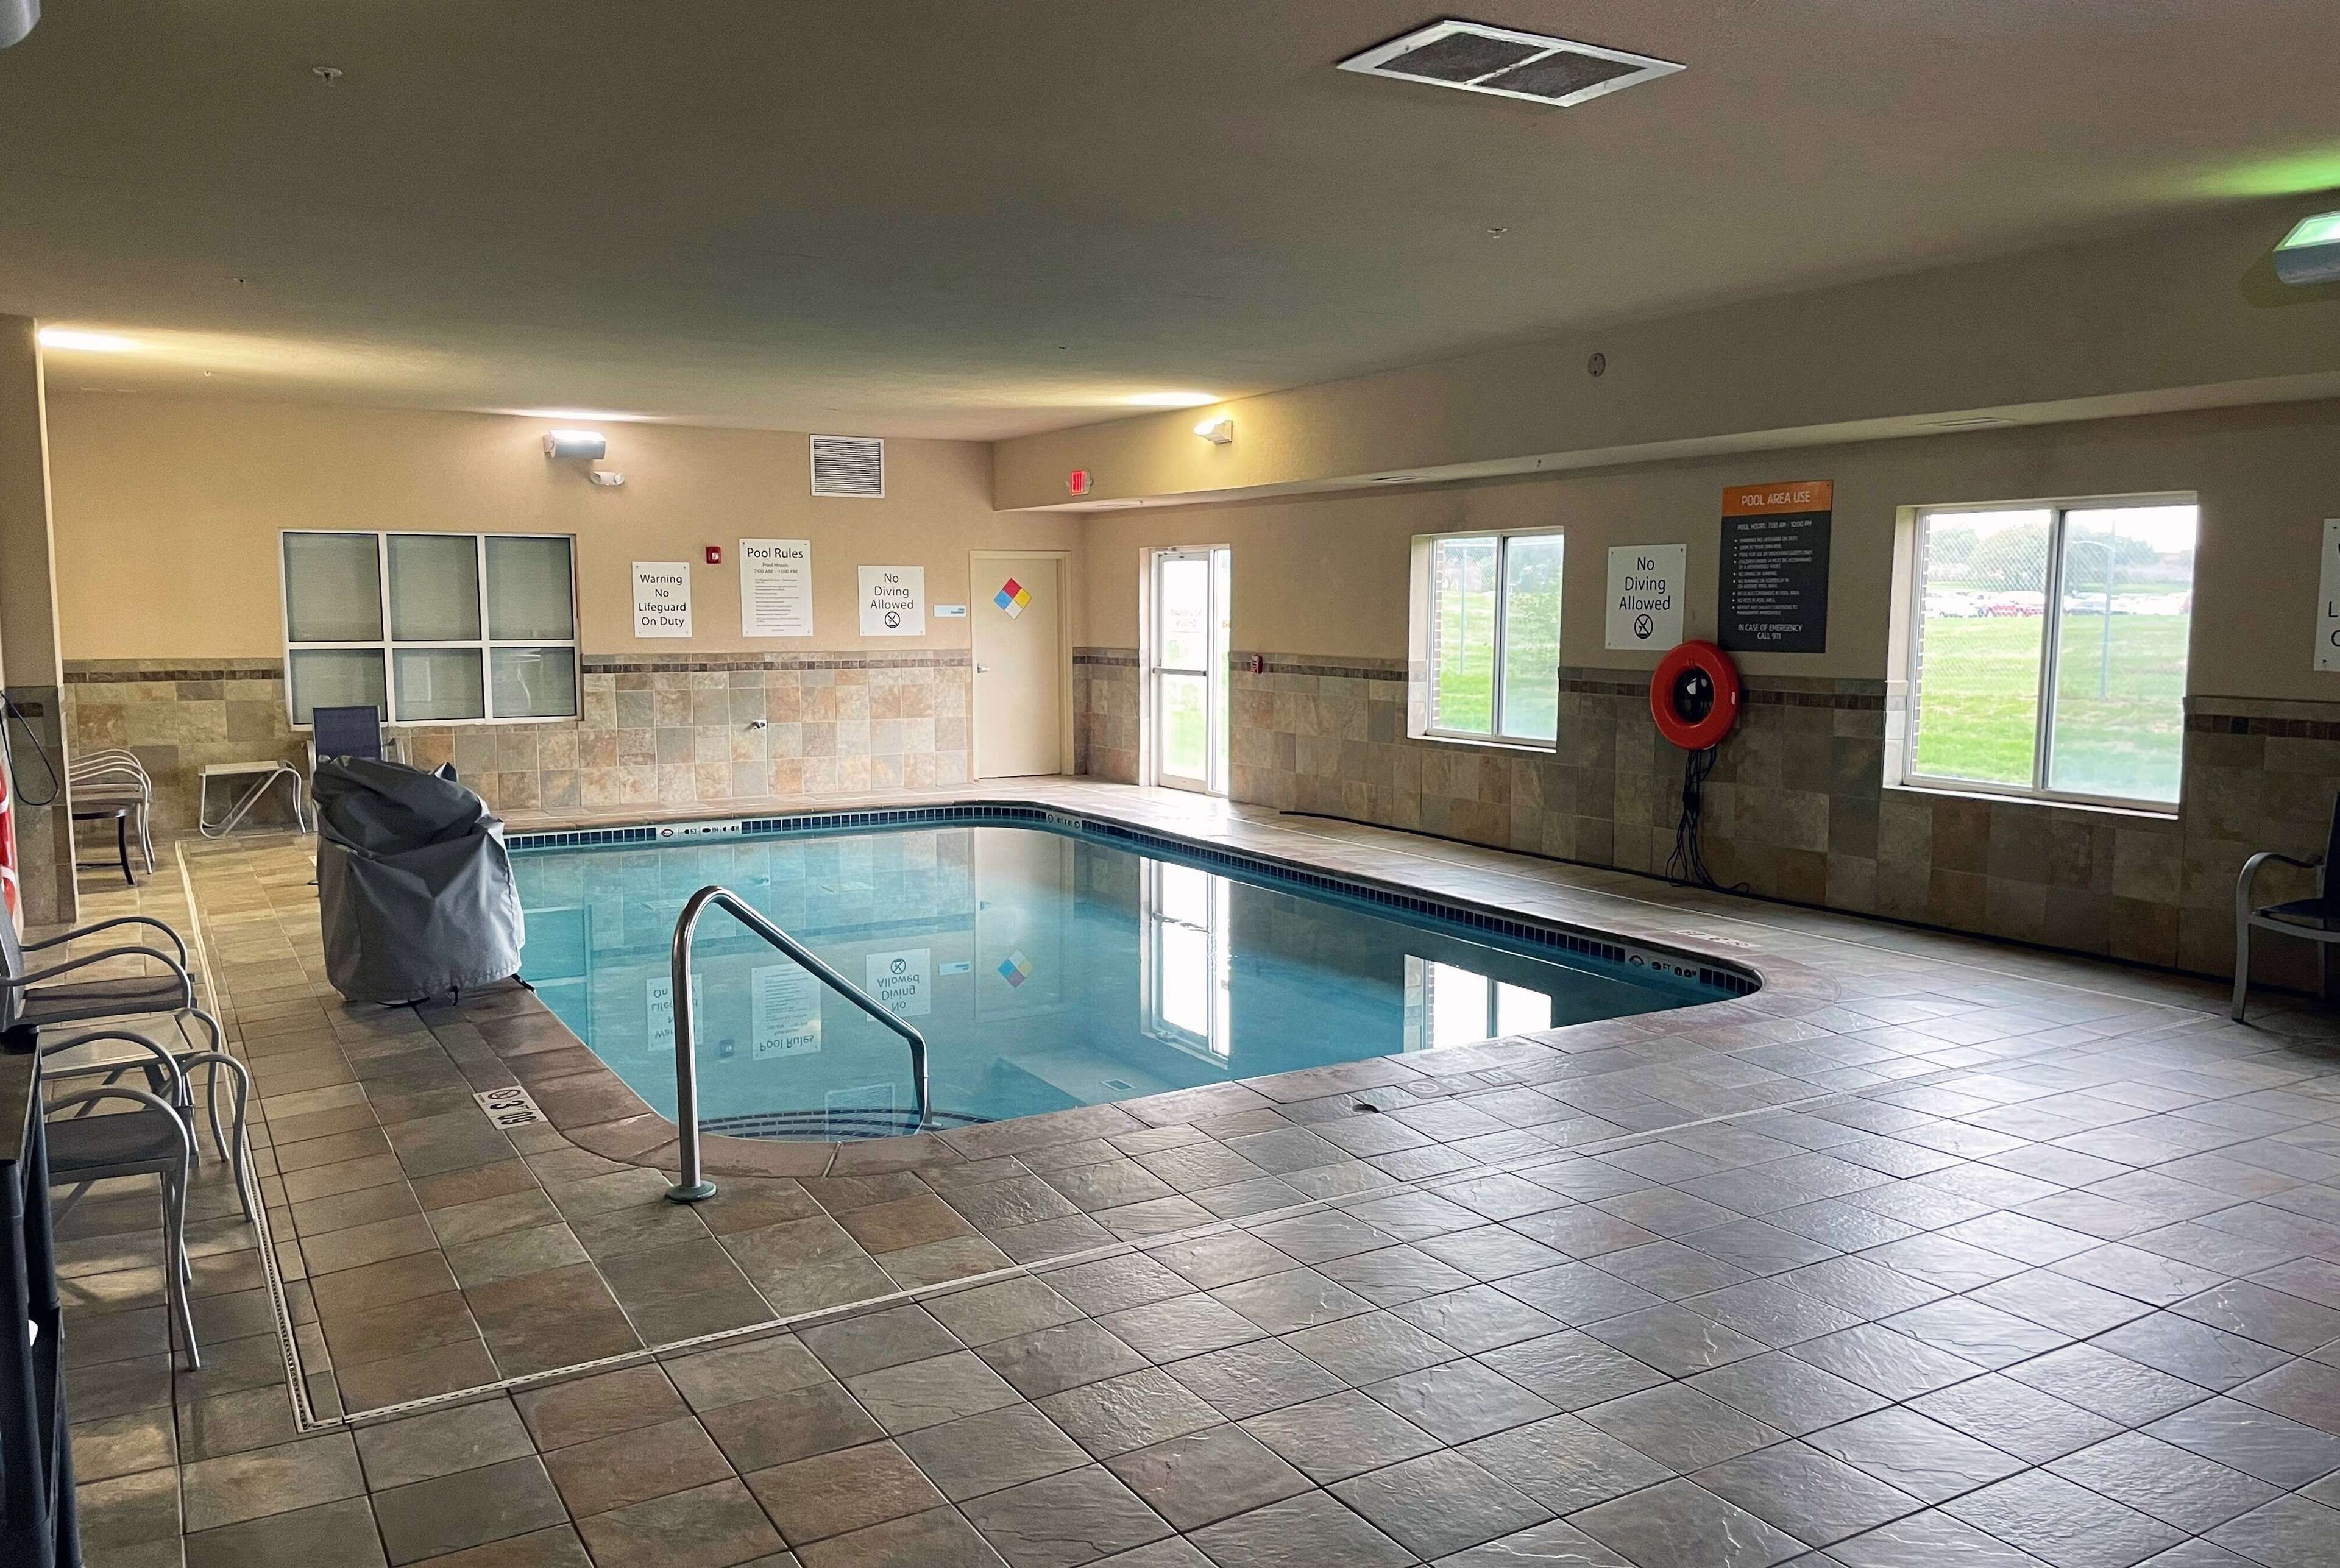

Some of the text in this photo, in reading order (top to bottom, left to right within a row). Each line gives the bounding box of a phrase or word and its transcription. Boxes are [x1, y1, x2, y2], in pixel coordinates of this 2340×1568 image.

[1742, 491, 1810, 506] POOL AREA USE
[747, 548, 803, 558] Pool Rules
[1637, 556, 1654, 570] No
[640, 575, 682, 585] Warning
[884, 573, 899, 583] No
[1625, 576, 1665, 594] Diving
[874, 586, 909, 598] Diving
[639, 603, 686, 613] Lifeguard
[870, 600, 913, 609] Allowed
[1619, 595, 1670, 611] Allowed
[642, 617, 684, 627] On Duty
